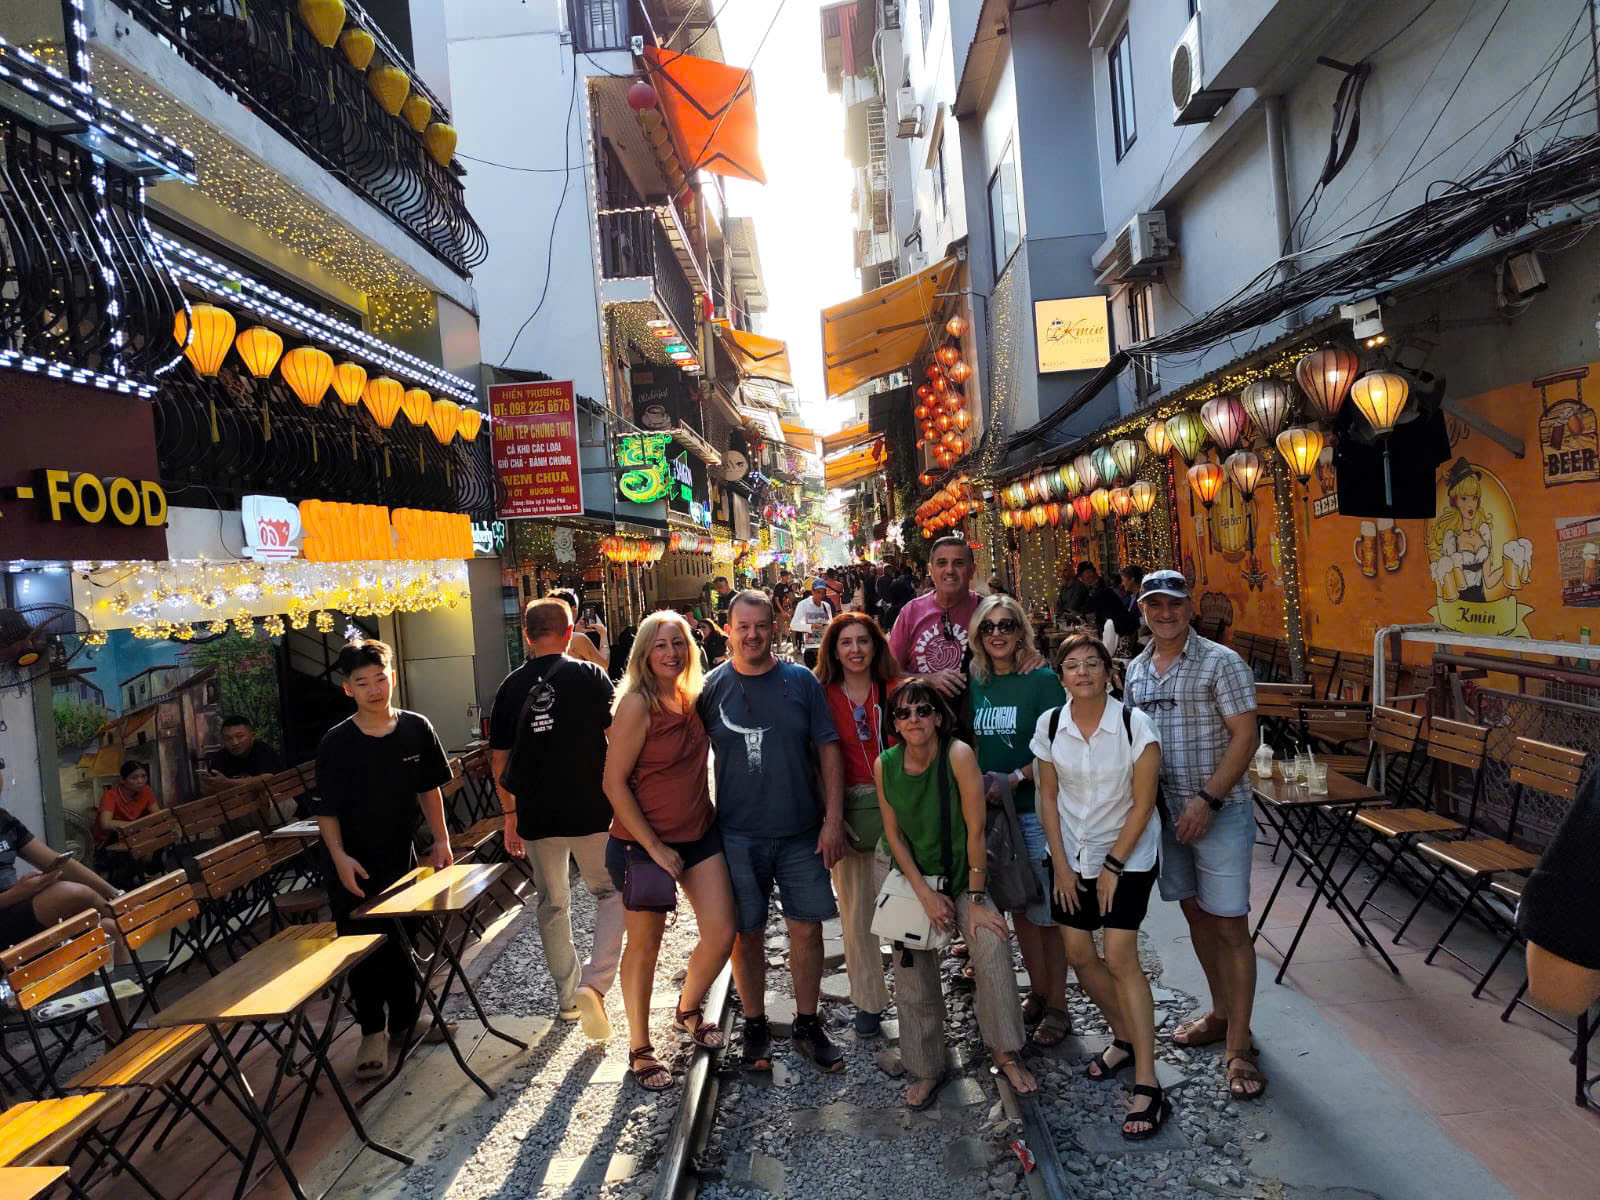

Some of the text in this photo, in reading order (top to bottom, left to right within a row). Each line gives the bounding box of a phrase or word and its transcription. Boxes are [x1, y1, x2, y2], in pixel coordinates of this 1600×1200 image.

[1062, 318, 1104, 340] Kmin
[510, 402, 526, 416] 098
[528, 400, 546, 414] 225
[547, 398, 570, 412] 6676
[517, 444, 530, 454] KHO
[1547, 448, 1594, 477] BEER
[503, 473, 533, 486] NEM
[46, 469, 168, 526] FOOD
[1457, 606, 1497, 625] Kmin
